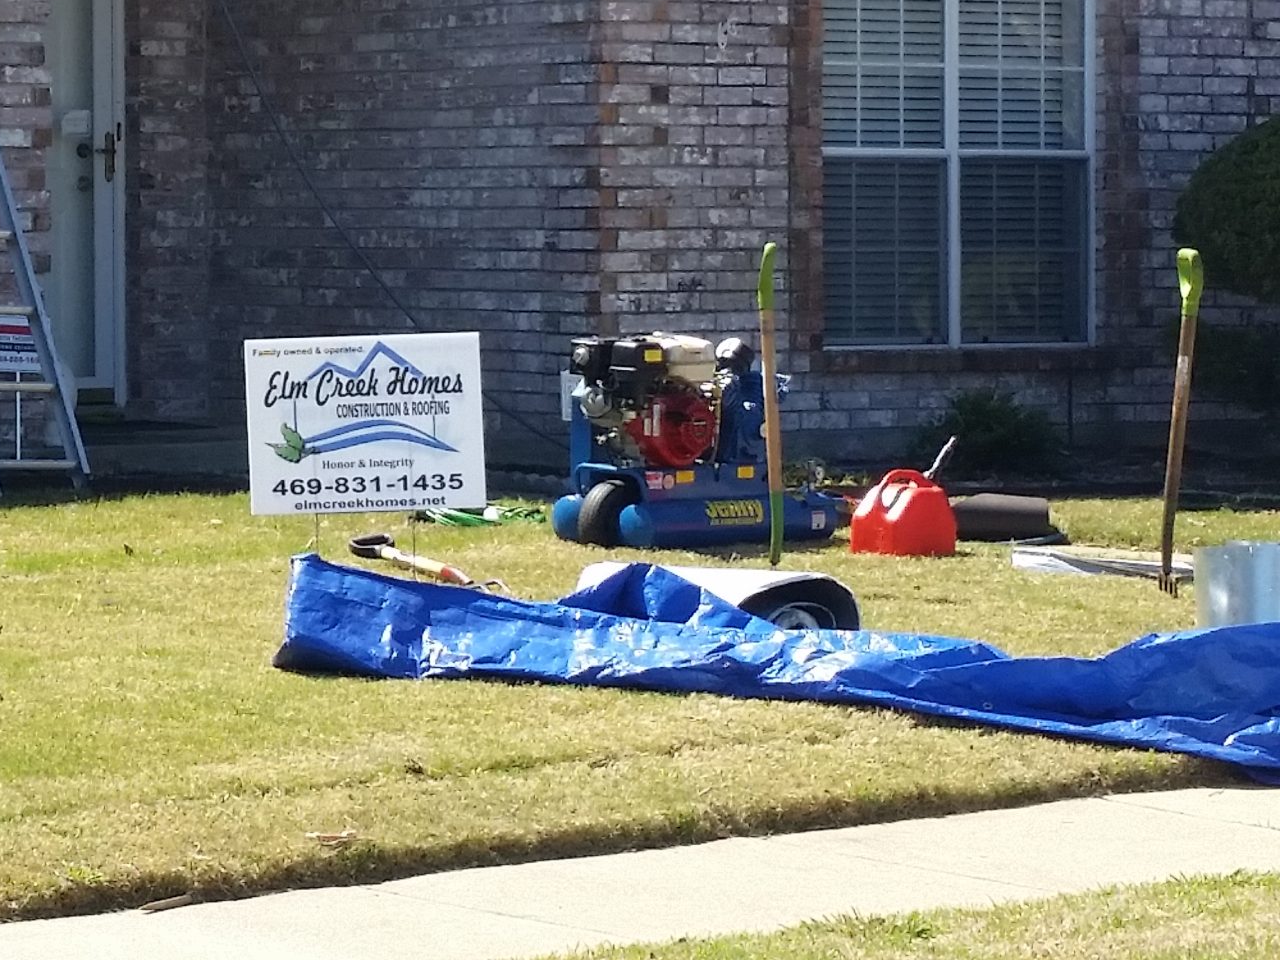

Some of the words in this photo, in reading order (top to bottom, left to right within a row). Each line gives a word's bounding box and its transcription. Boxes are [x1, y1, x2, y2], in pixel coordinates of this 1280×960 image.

[264, 370, 308, 408] Elm
[315, 367, 379, 406] Creek
[386, 366, 463, 396] Homes
[336, 401, 402, 419] CONSTRUCTION
[403, 401, 410, 416] &
[411, 400, 450, 416] ROOFING
[322, 459, 356, 470] Honor
[358, 458, 366, 468] &
[369, 457, 415, 469] Integrity
[272, 473, 464, 496] 469-831-1435
[294, 496, 446, 511] elmcreekhomes.net
